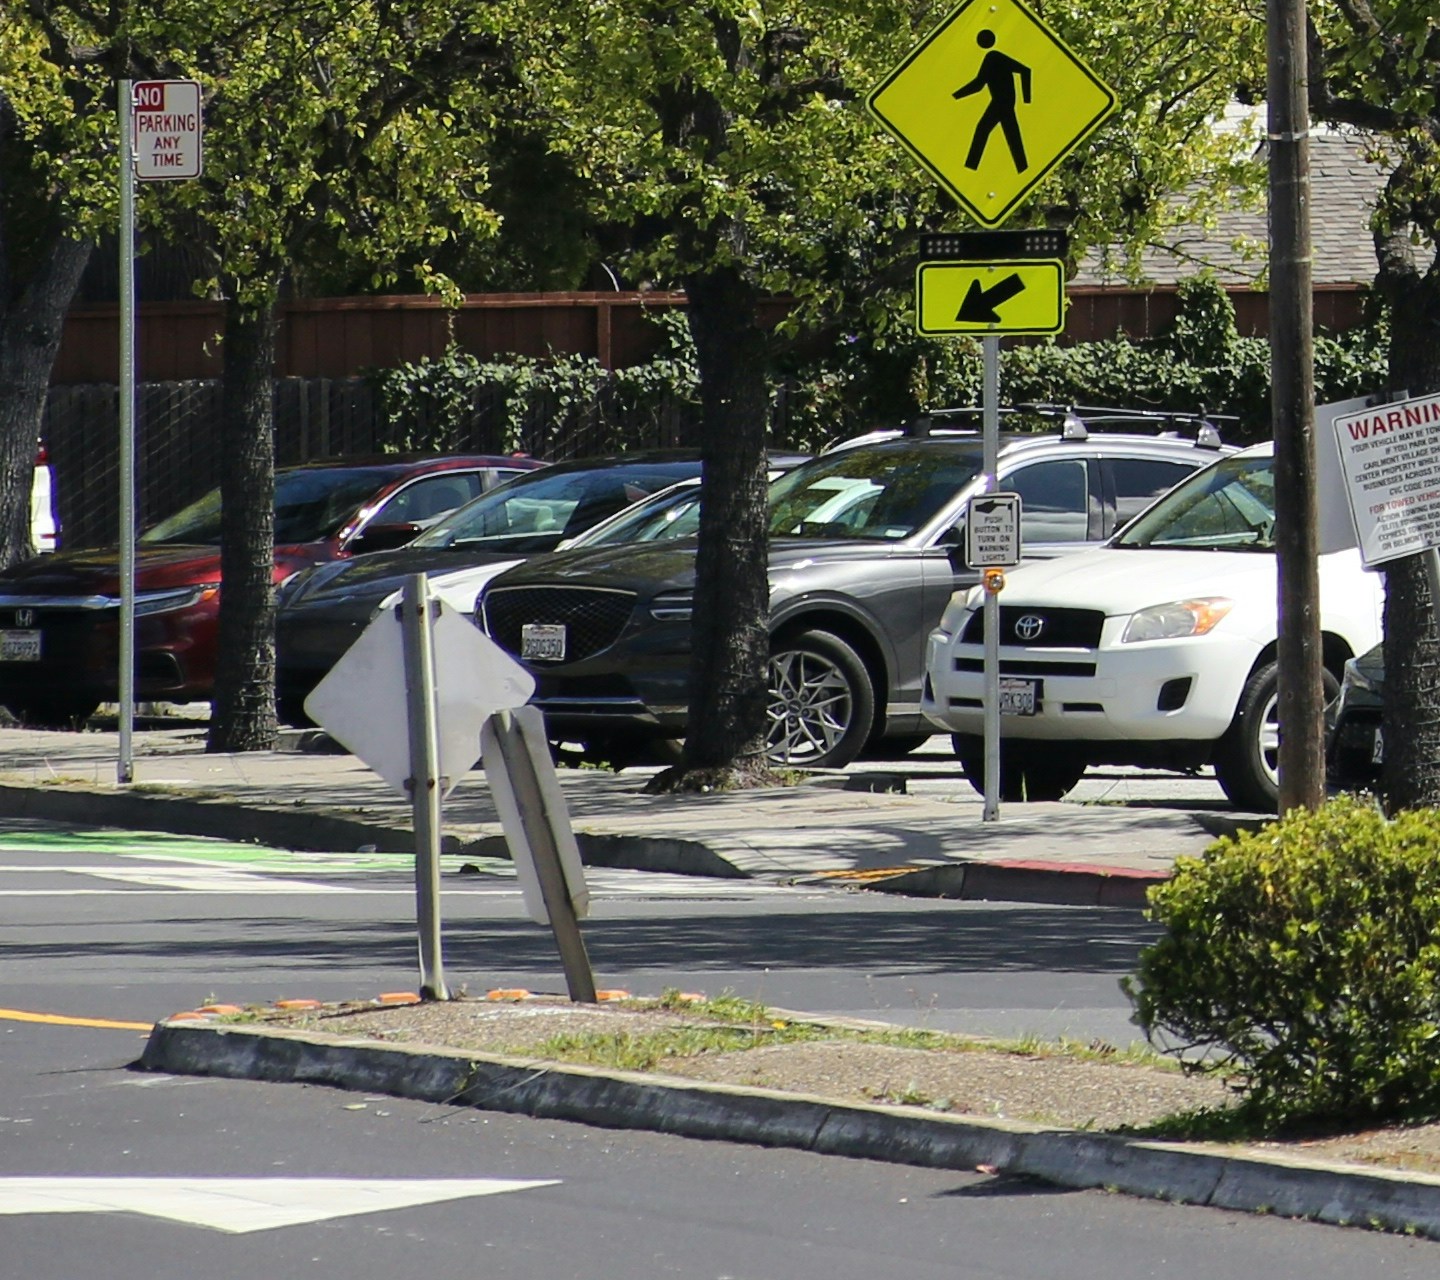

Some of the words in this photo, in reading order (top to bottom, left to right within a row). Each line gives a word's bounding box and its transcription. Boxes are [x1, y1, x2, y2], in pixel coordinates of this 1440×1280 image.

[138, 87, 161, 106] NO
[139, 114, 195, 133] PARKING
[154, 136, 181, 149] ANY
[152, 153, 184, 167] TIME
[1399, 432, 1413, 441] MAY
[1401, 449, 1429, 460] VILLAGE
